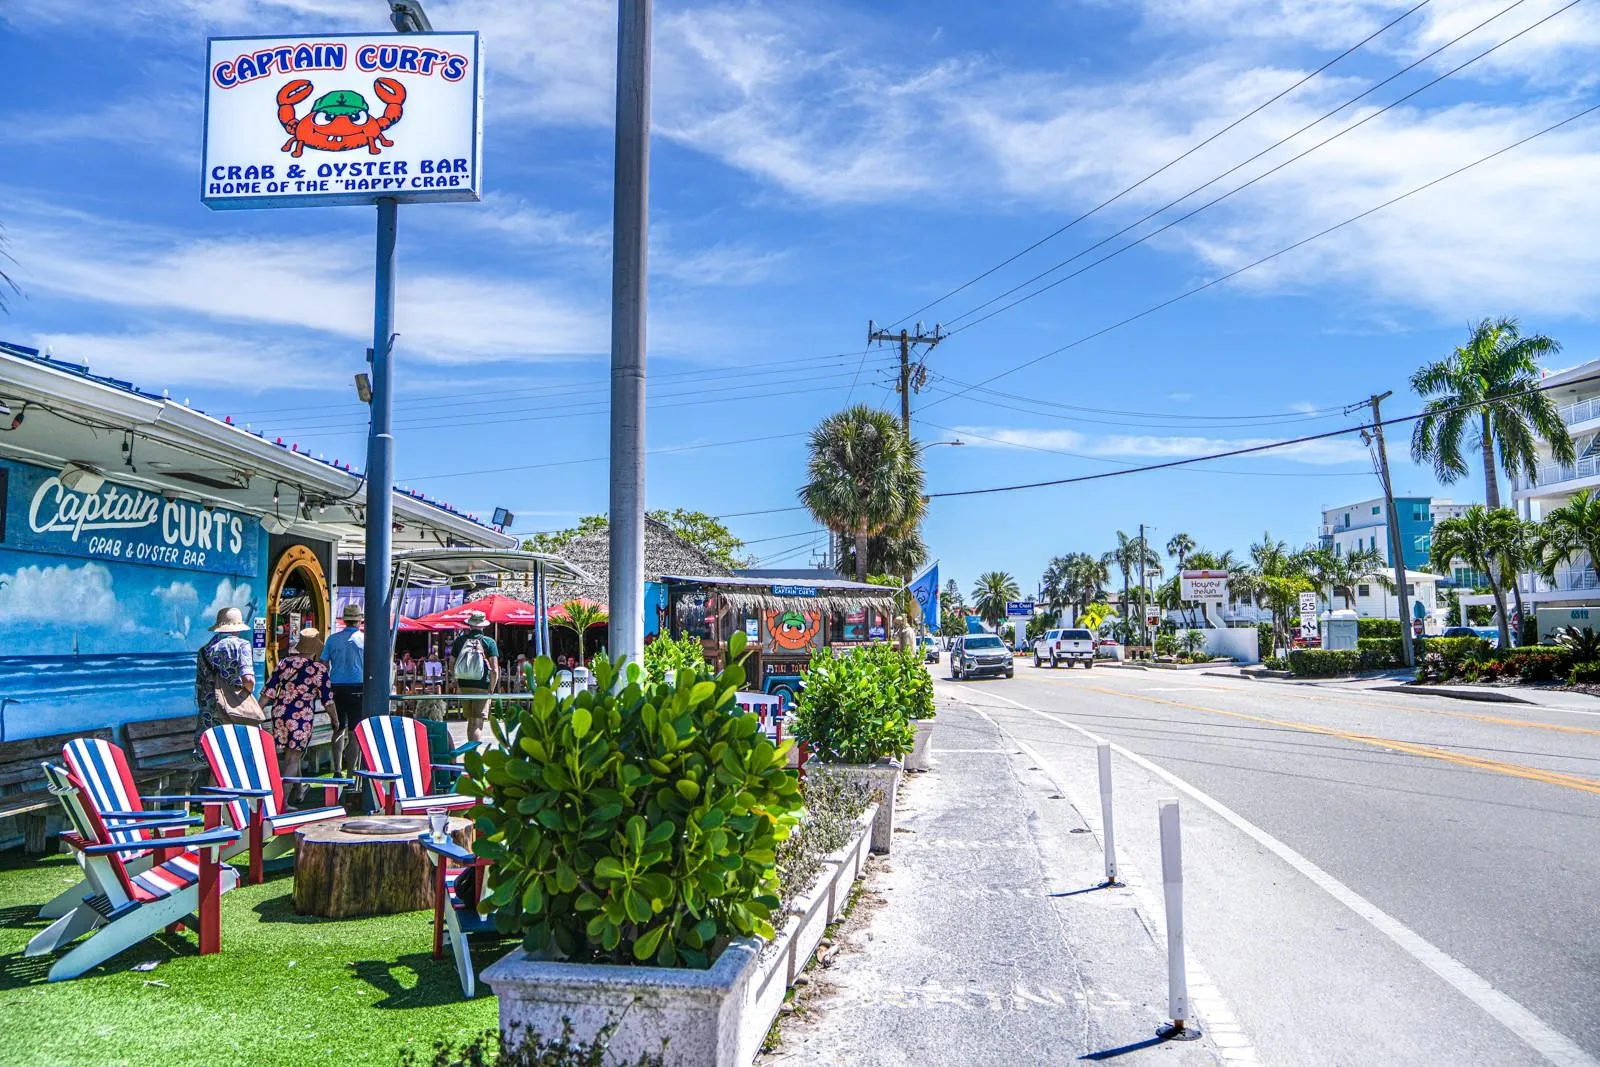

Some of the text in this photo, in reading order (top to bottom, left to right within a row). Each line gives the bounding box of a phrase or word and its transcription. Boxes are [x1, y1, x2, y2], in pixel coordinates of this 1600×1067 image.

[214, 44, 468, 88] CAPTAIN CURT'S
[211, 158, 468, 180] CRAB & OYSTER BAR
[209, 175, 470, 194] HOME OF THE "HAPPY CRAB"
[28, 475, 243, 554] Captain CURT'S
[88, 537, 207, 567] CRAB & OYSTER BAR
[1301, 602, 1315, 610] 25
